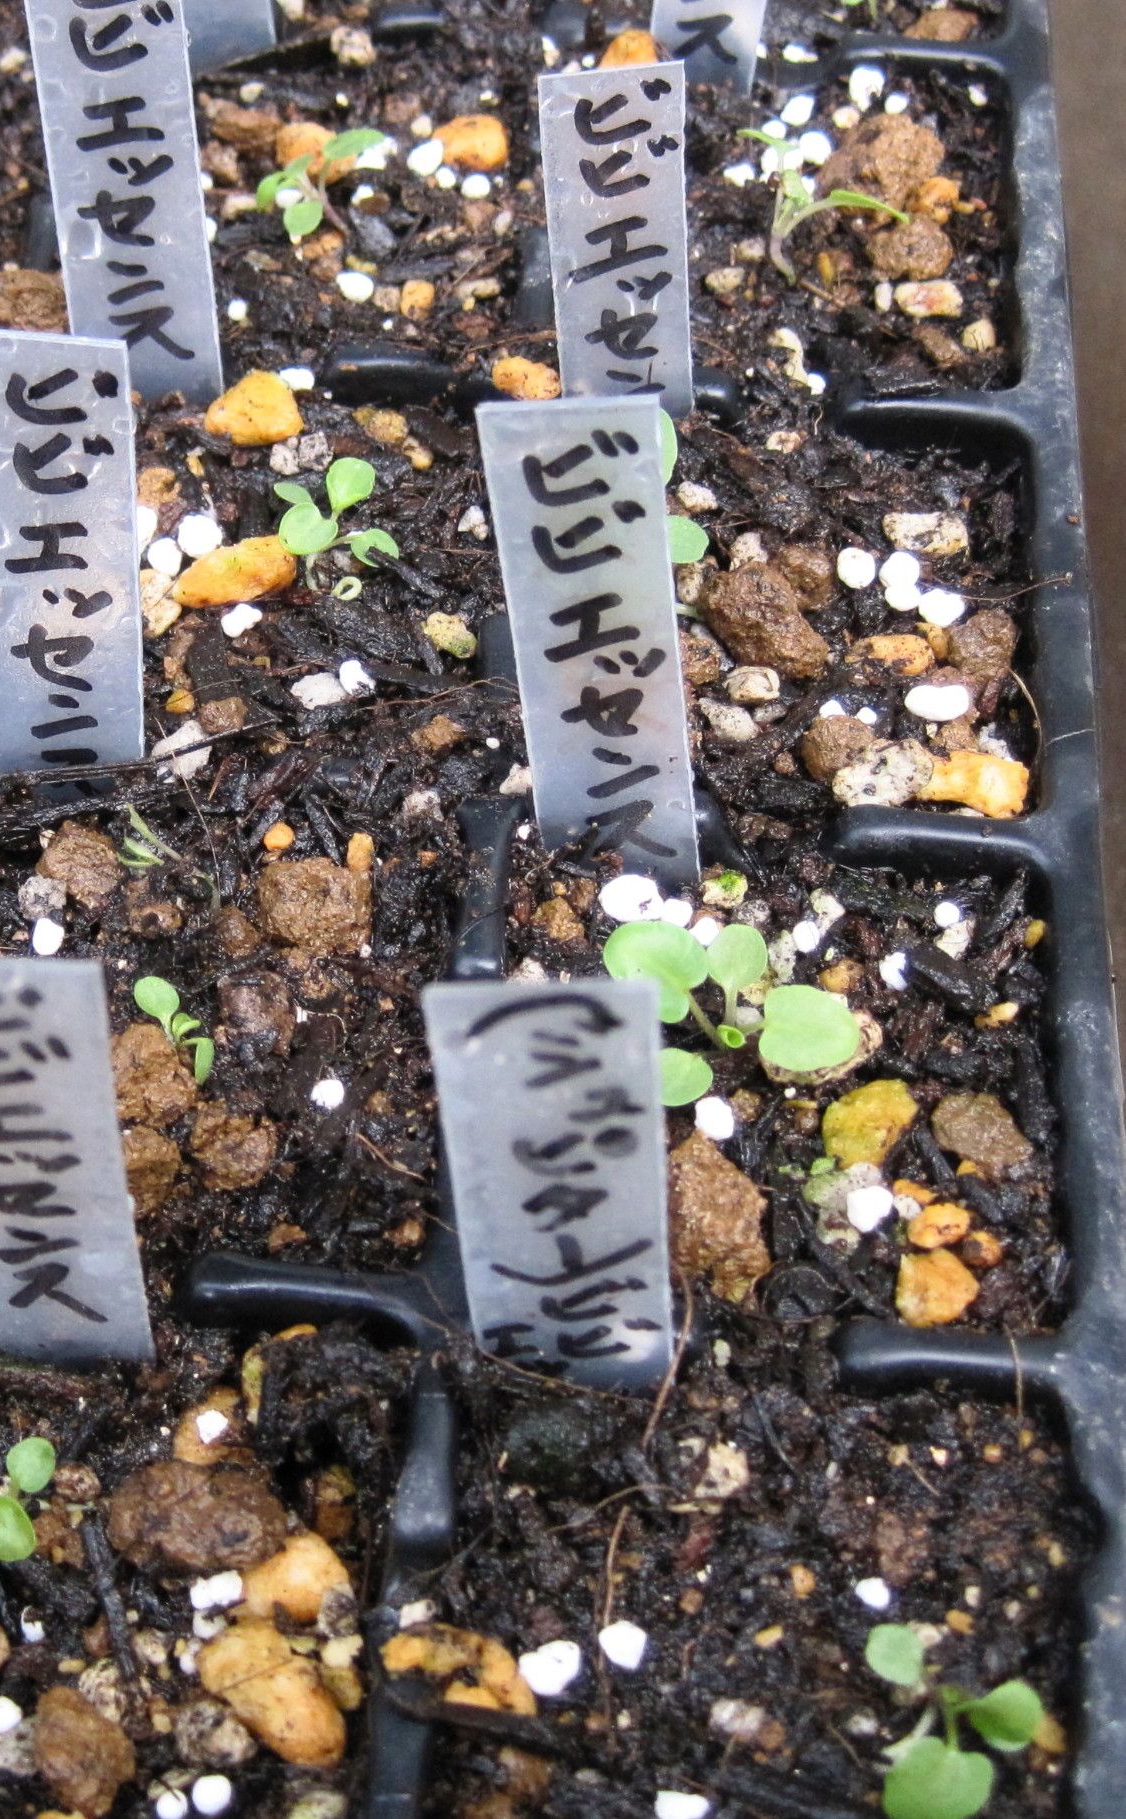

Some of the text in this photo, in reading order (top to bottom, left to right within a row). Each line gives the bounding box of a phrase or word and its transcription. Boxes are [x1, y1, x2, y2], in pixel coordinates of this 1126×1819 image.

[69, 0, 196, 360] ビエッセンス
[522, 428, 678, 858] ビビエッセンス
